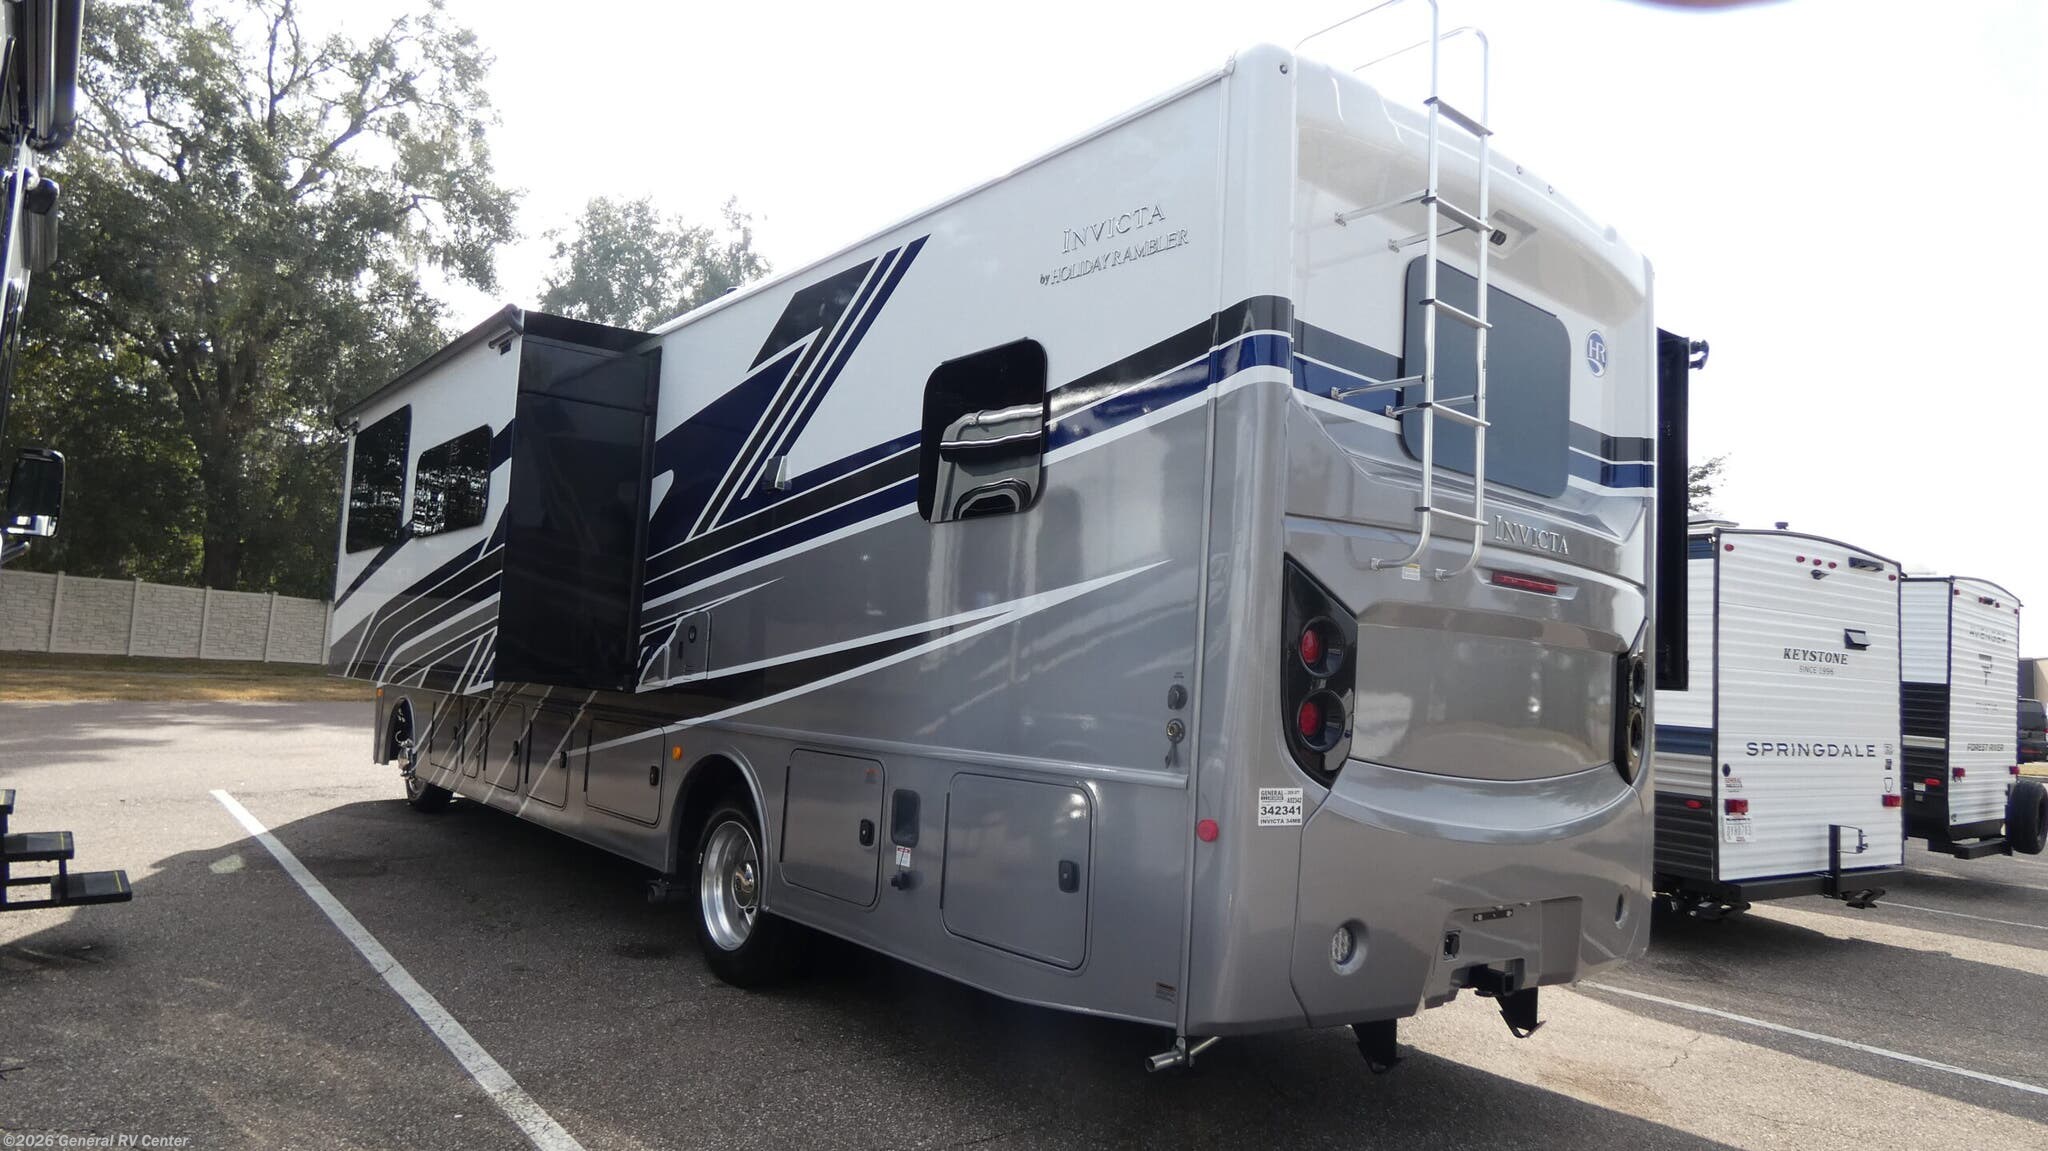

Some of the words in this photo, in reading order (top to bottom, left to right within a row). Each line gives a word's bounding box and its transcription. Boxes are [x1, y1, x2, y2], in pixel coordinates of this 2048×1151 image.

[1062, 203, 1166, 253] INVICTA
[1040, 274, 1050, 285] by
[1051, 253, 1112, 285] HOLIDAY
[1112, 229, 1189, 267] RAMBLER
[1495, 514, 1569, 555] INVICTA
[1783, 648, 1848, 665] KEYSTONE
[1746, 742, 1876, 758] SPRINGDALE
[1261, 806, 1301, 815] 342341
